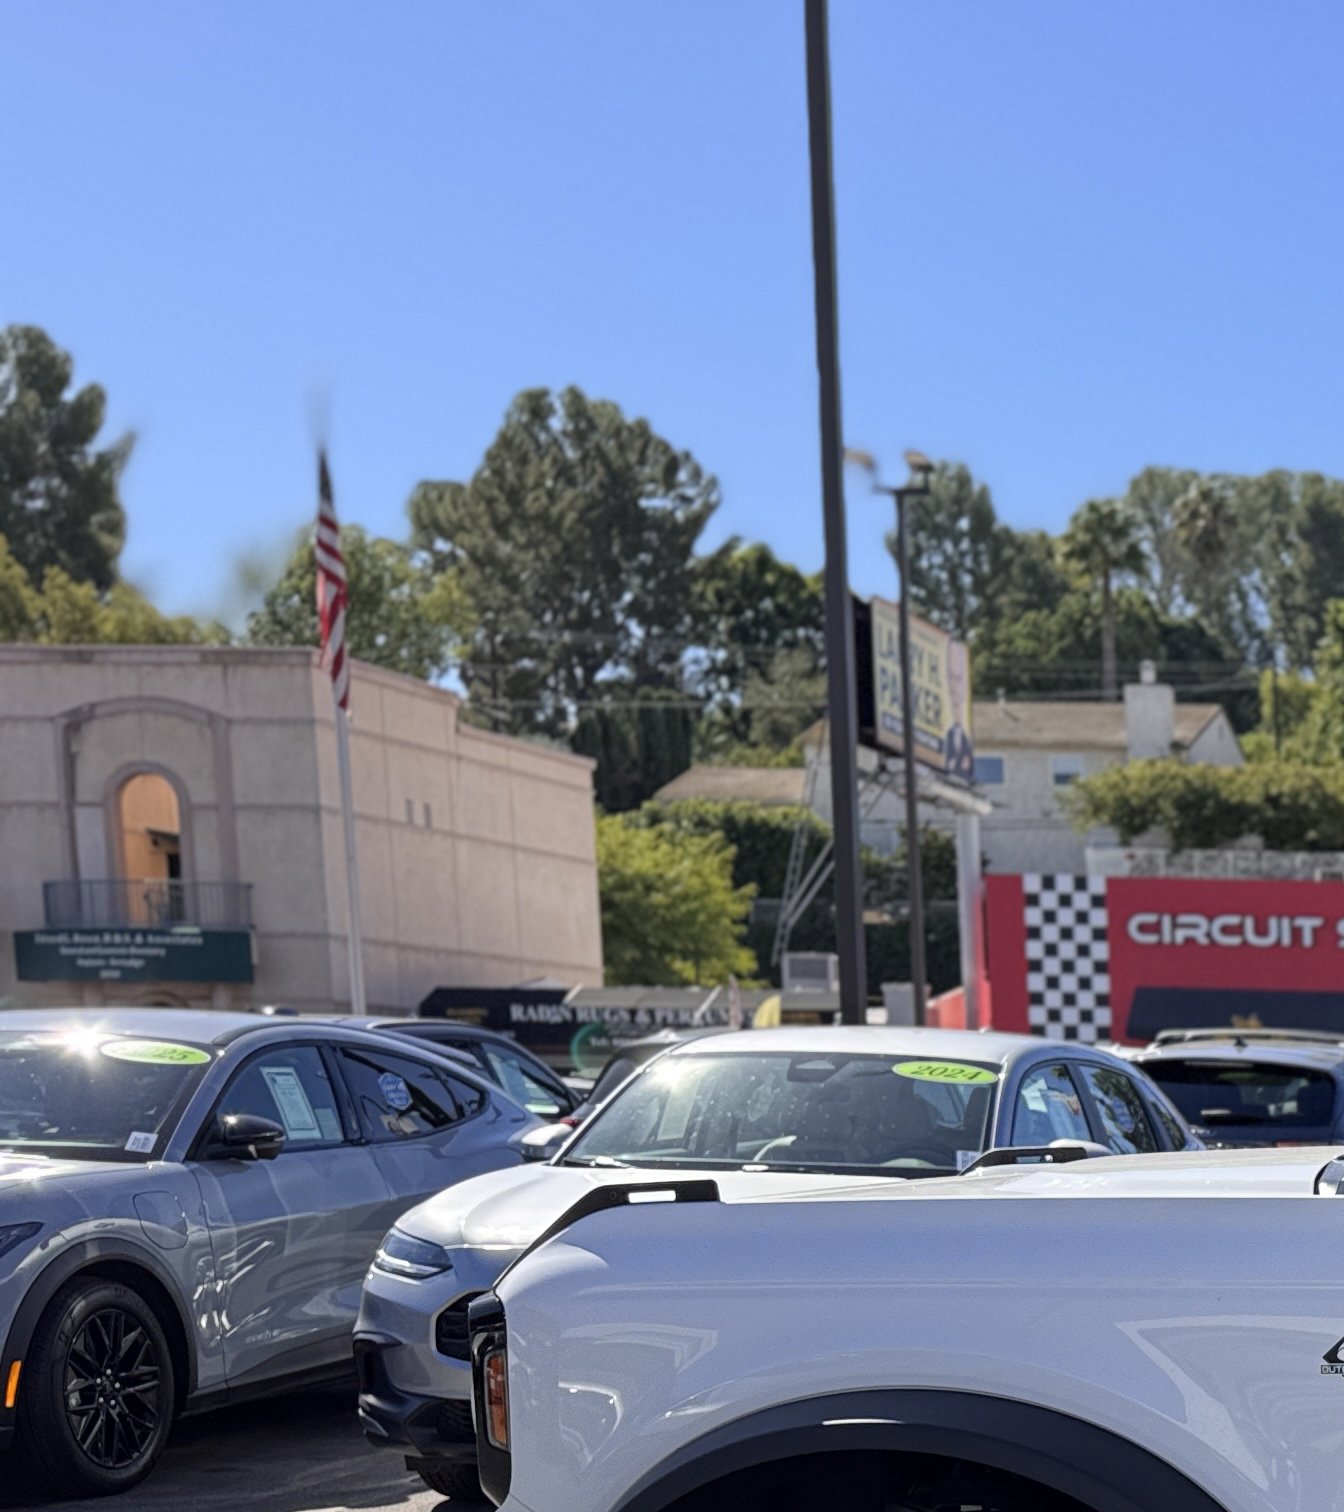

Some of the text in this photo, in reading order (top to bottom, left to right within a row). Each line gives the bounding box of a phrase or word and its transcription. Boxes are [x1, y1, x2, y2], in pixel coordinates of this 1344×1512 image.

[1127, 912, 1324, 948] CIRCUIT
[576, 1006, 632, 1024] RUGS
[635, 1007, 651, 1024] &
[910, 1065, 982, 1080] 2024
